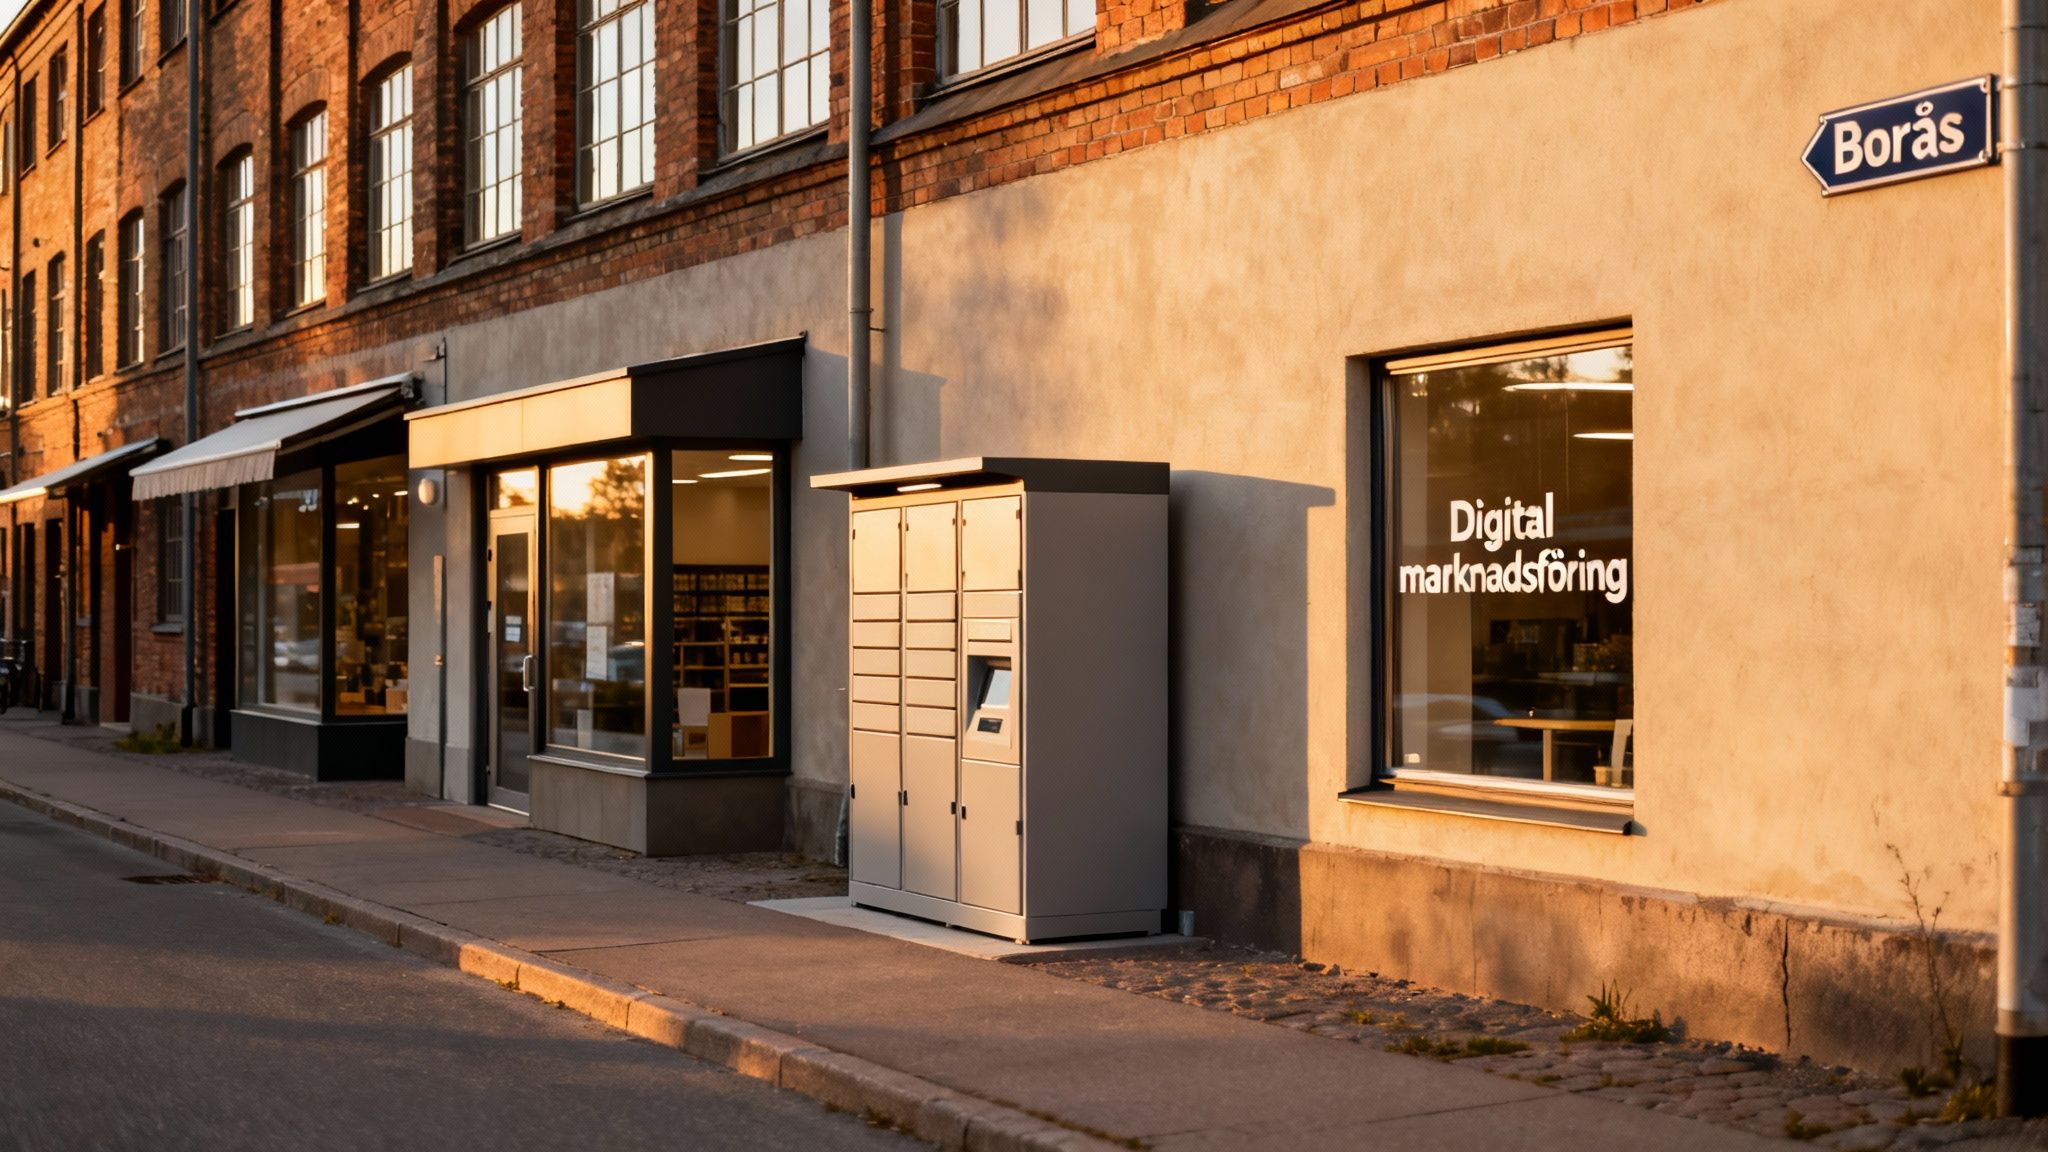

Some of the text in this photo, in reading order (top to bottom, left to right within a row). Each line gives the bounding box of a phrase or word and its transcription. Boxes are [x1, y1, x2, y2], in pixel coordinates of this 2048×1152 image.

[1834, 101, 1965, 175] Borås
[1450, 491, 1554, 552] Digital
[1399, 548, 1628, 604] marknadsföring
